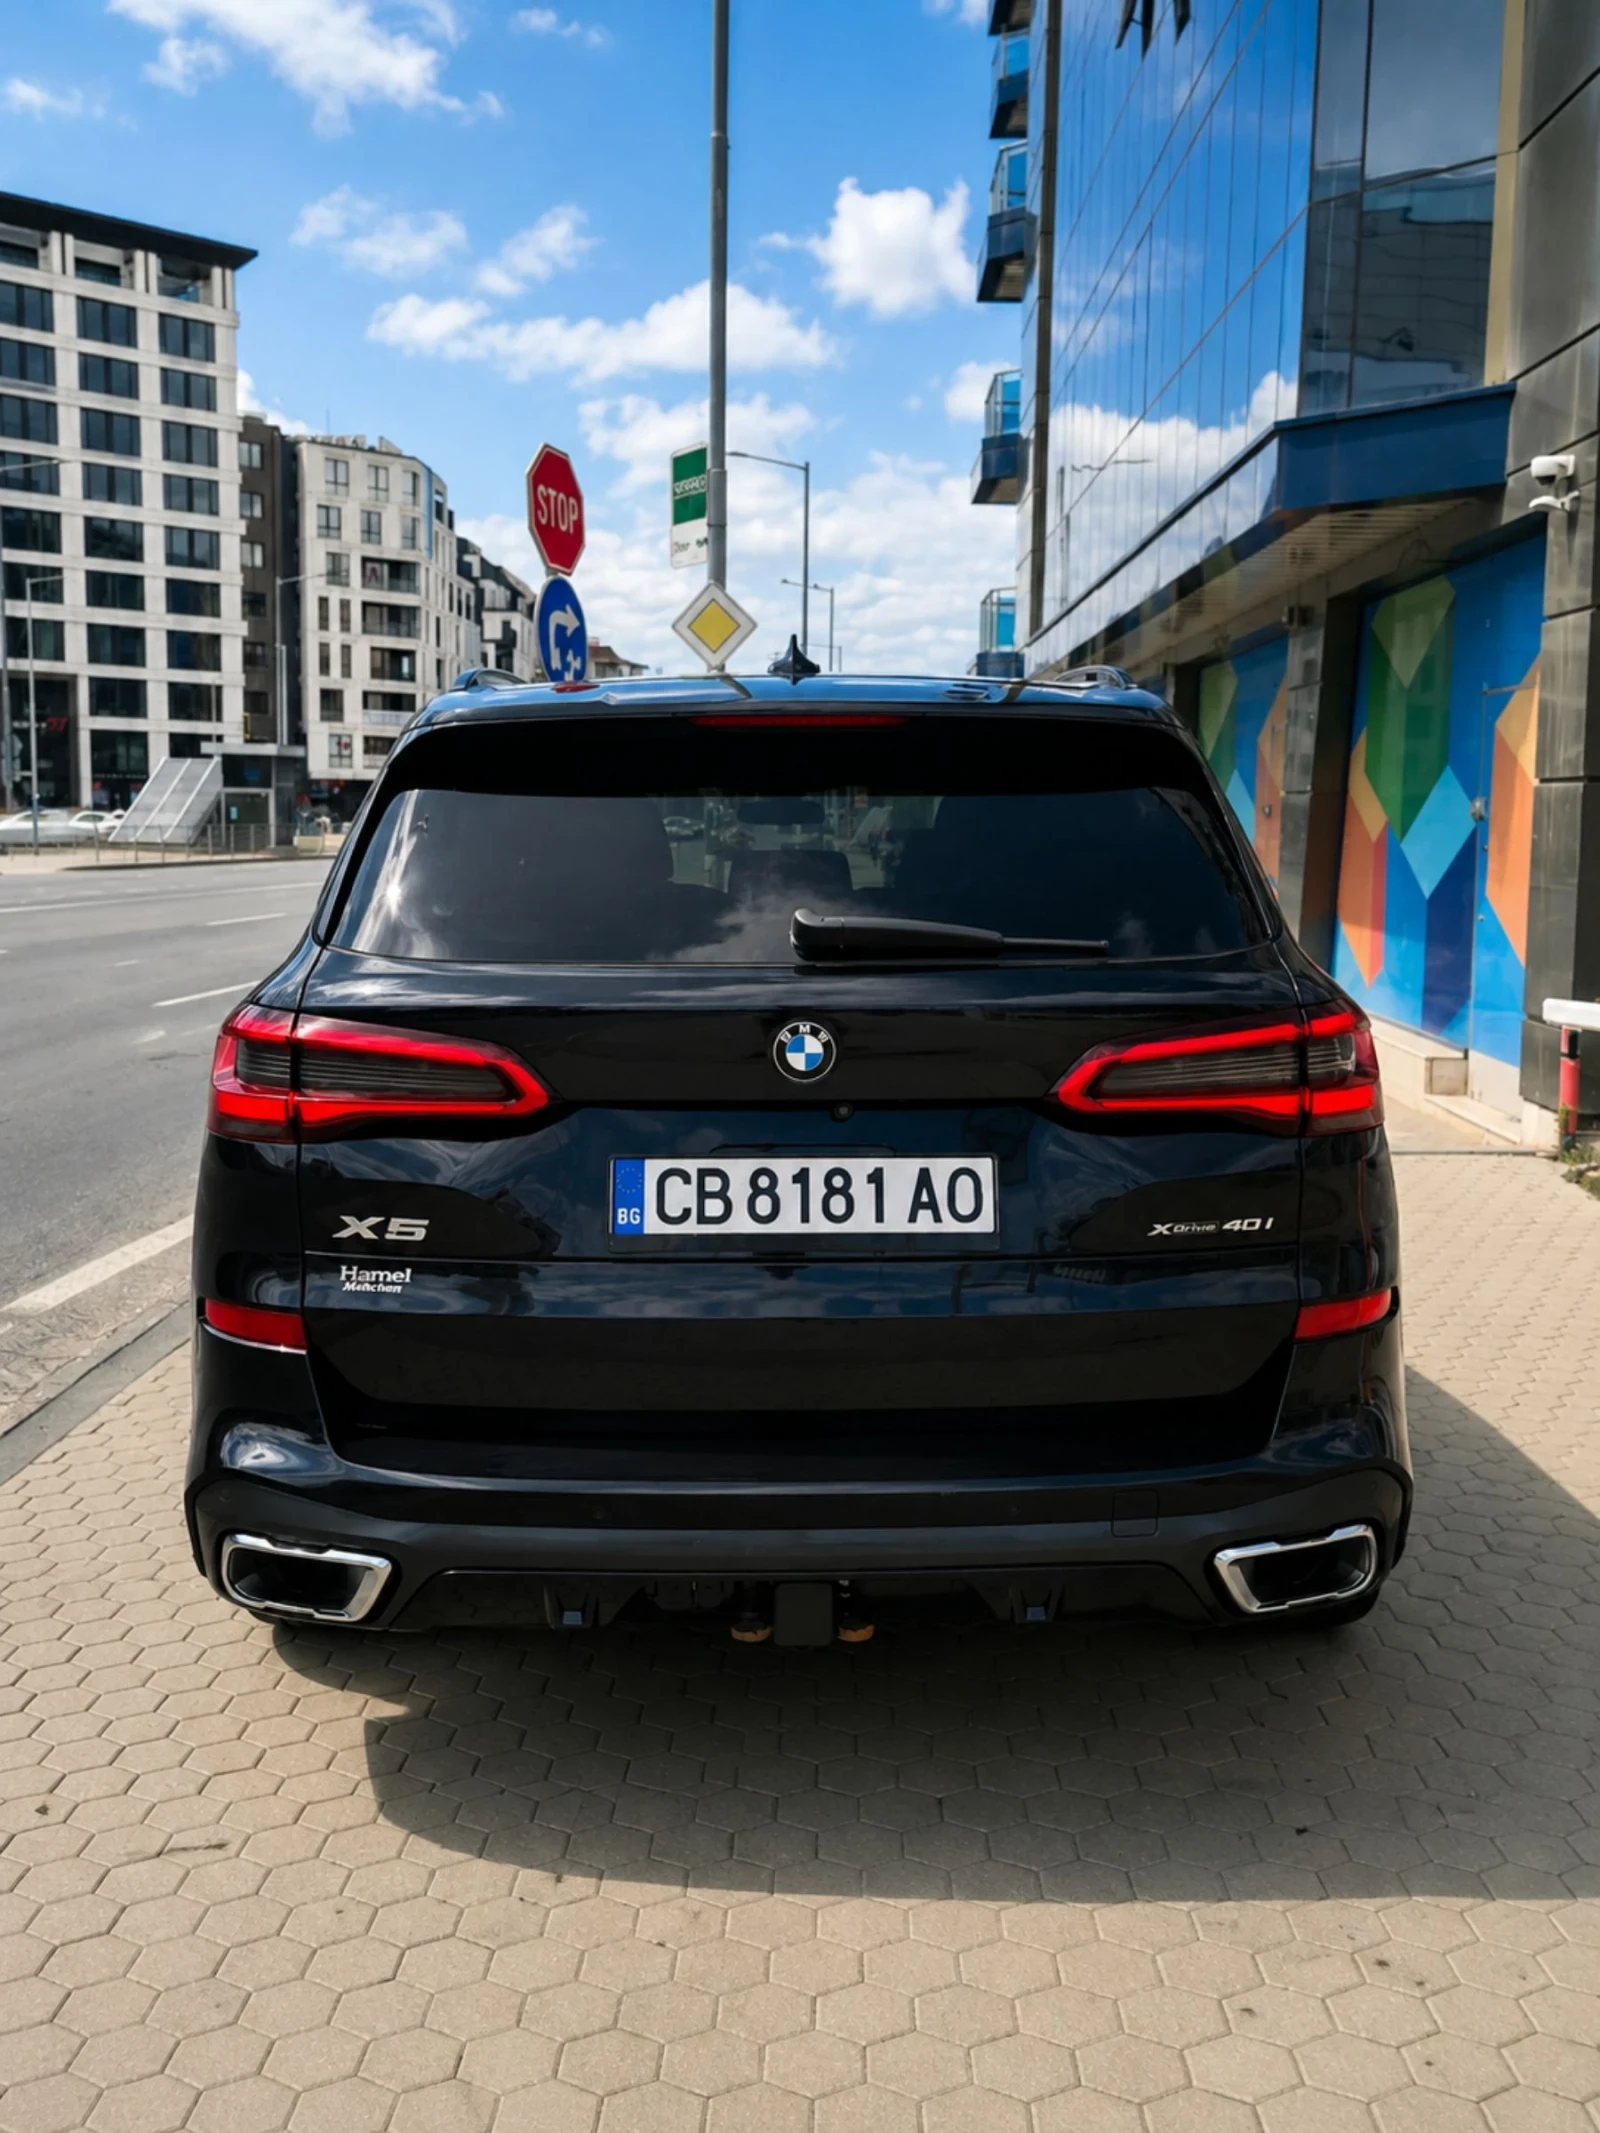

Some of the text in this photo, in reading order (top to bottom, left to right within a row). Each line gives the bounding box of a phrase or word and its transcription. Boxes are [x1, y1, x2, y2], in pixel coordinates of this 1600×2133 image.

[537, 484, 579, 534] STOP
[656, 1167, 984, 1225] CB 8181 AO
[331, 1215, 430, 1241] X5
[617, 1207, 641, 1225] BG
[340, 1265, 412, 1283] Hamel
